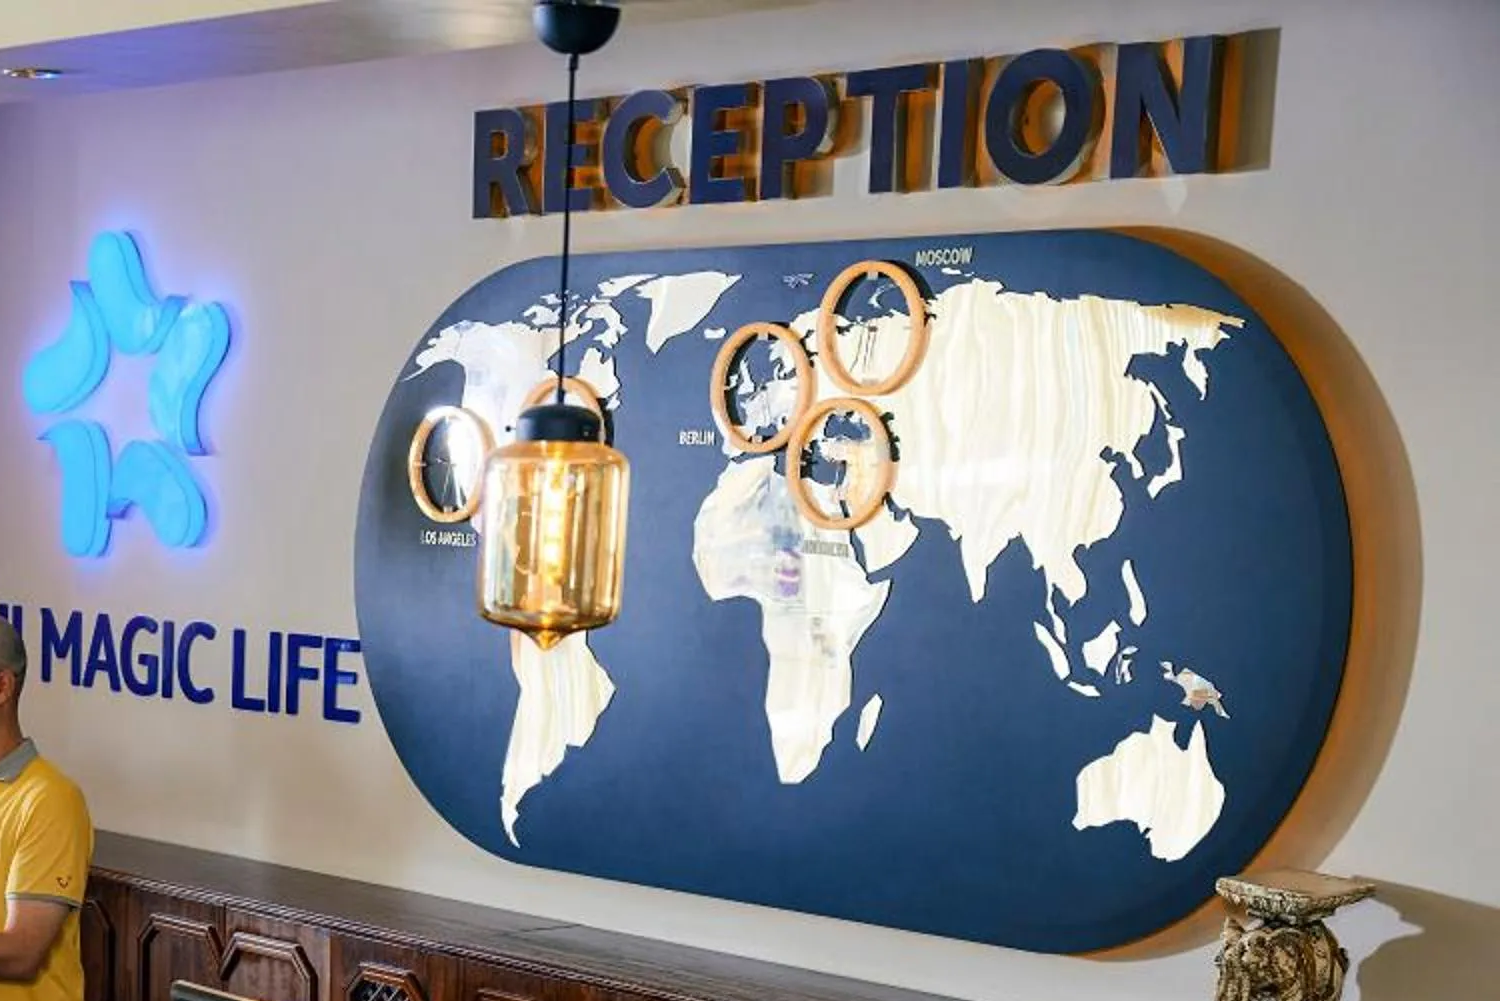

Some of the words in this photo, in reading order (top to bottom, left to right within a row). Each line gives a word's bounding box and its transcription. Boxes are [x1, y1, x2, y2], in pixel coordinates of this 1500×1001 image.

[473, 34, 1228, 219] RECEPTION
[915, 247, 973, 266] MOSCOW
[678, 430, 715, 446] BERLIN
[420, 530, 437, 545] LOS
[438, 531, 477, 547] ANGELES
[40, 607, 216, 704] MAGIC
[231, 629, 361, 724] LIFE
